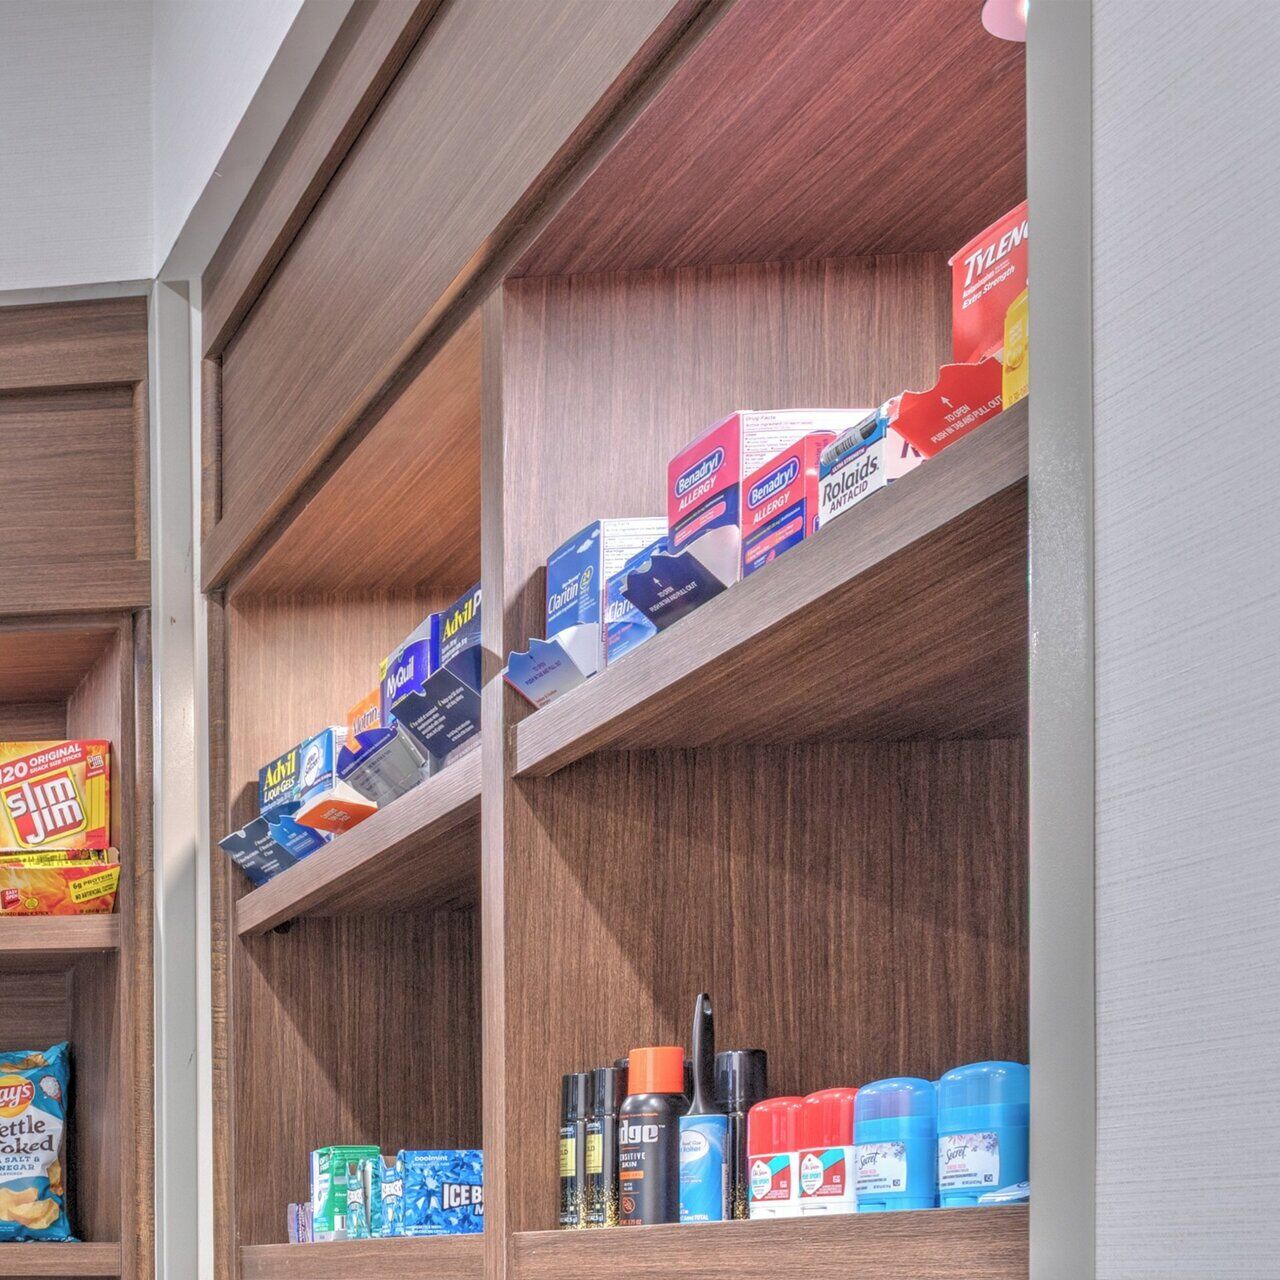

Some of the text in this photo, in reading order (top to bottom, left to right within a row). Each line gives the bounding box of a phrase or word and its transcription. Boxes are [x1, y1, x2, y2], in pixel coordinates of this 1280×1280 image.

[961, 290, 982, 310] Extra
[930, 394, 1003, 443] PUSH PULL OUT
[943, 403, 971, 423] TO OPEN
[678, 451, 721, 491] Benadryl
[751, 462, 795, 503] Benadryl
[822, 455, 878, 507] Rolaids
[678, 475, 717, 512] ALLERGY
[752, 491, 790, 526] ALLERGY
[829, 480, 869, 514] ANTACID
[547, 581, 579, 616] Claritin
[442, 598, 473, 642] Advil
[386, 655, 416, 698] NyQuil
[29, 743, 82, 767] ORIGINAL
[29, 763, 49, 774] SNACK
[263, 750, 296, 791] Advil
[3, 1156, 32, 1165] SALT
[621, 1160, 638, 1168] SKIN
[945, 1144, 968, 1165] Secret
[443, 1183, 470, 1210] ICE
